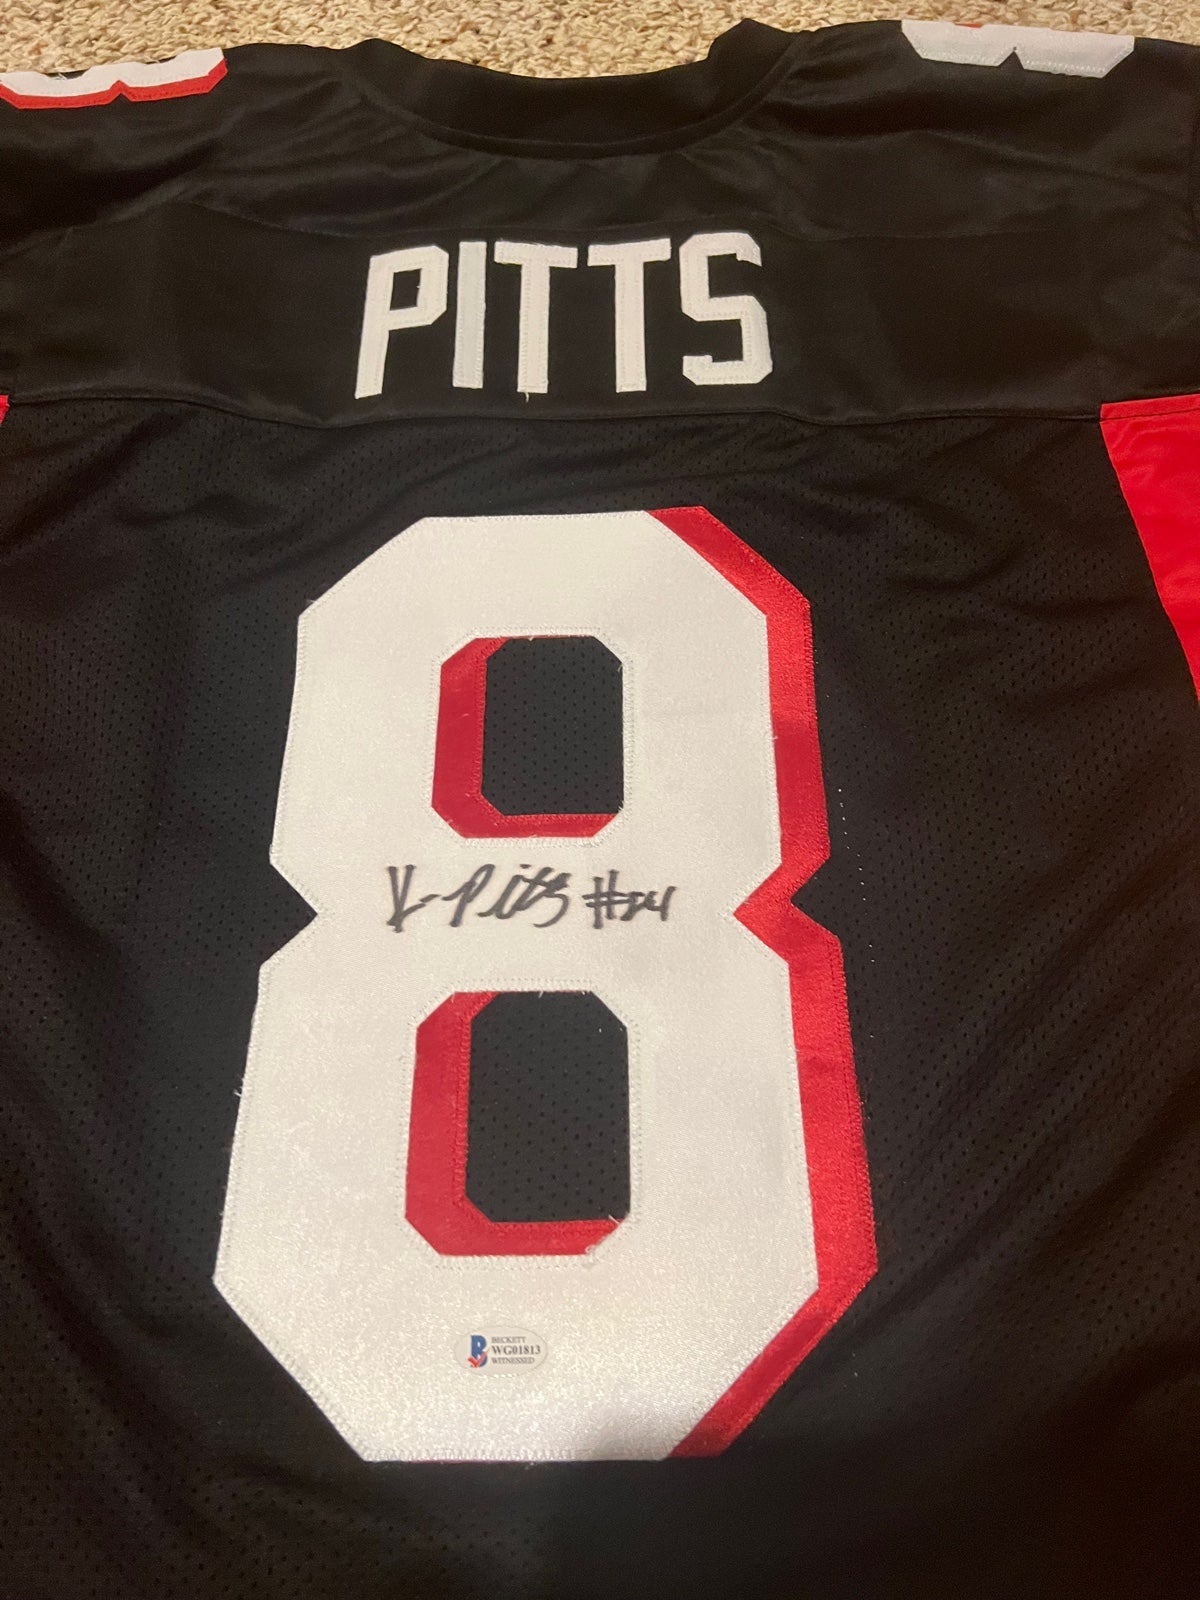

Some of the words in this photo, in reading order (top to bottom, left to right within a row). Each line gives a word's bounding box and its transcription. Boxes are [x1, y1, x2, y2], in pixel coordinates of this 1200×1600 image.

[354, 231, 774, 400] PITTS
[213, 505, 878, 1463] 8
[491, 1336, 526, 1344] BECKETT
[491, 1345, 541, 1355] WG01813
[491, 1357, 535, 1365] WITNESSED
